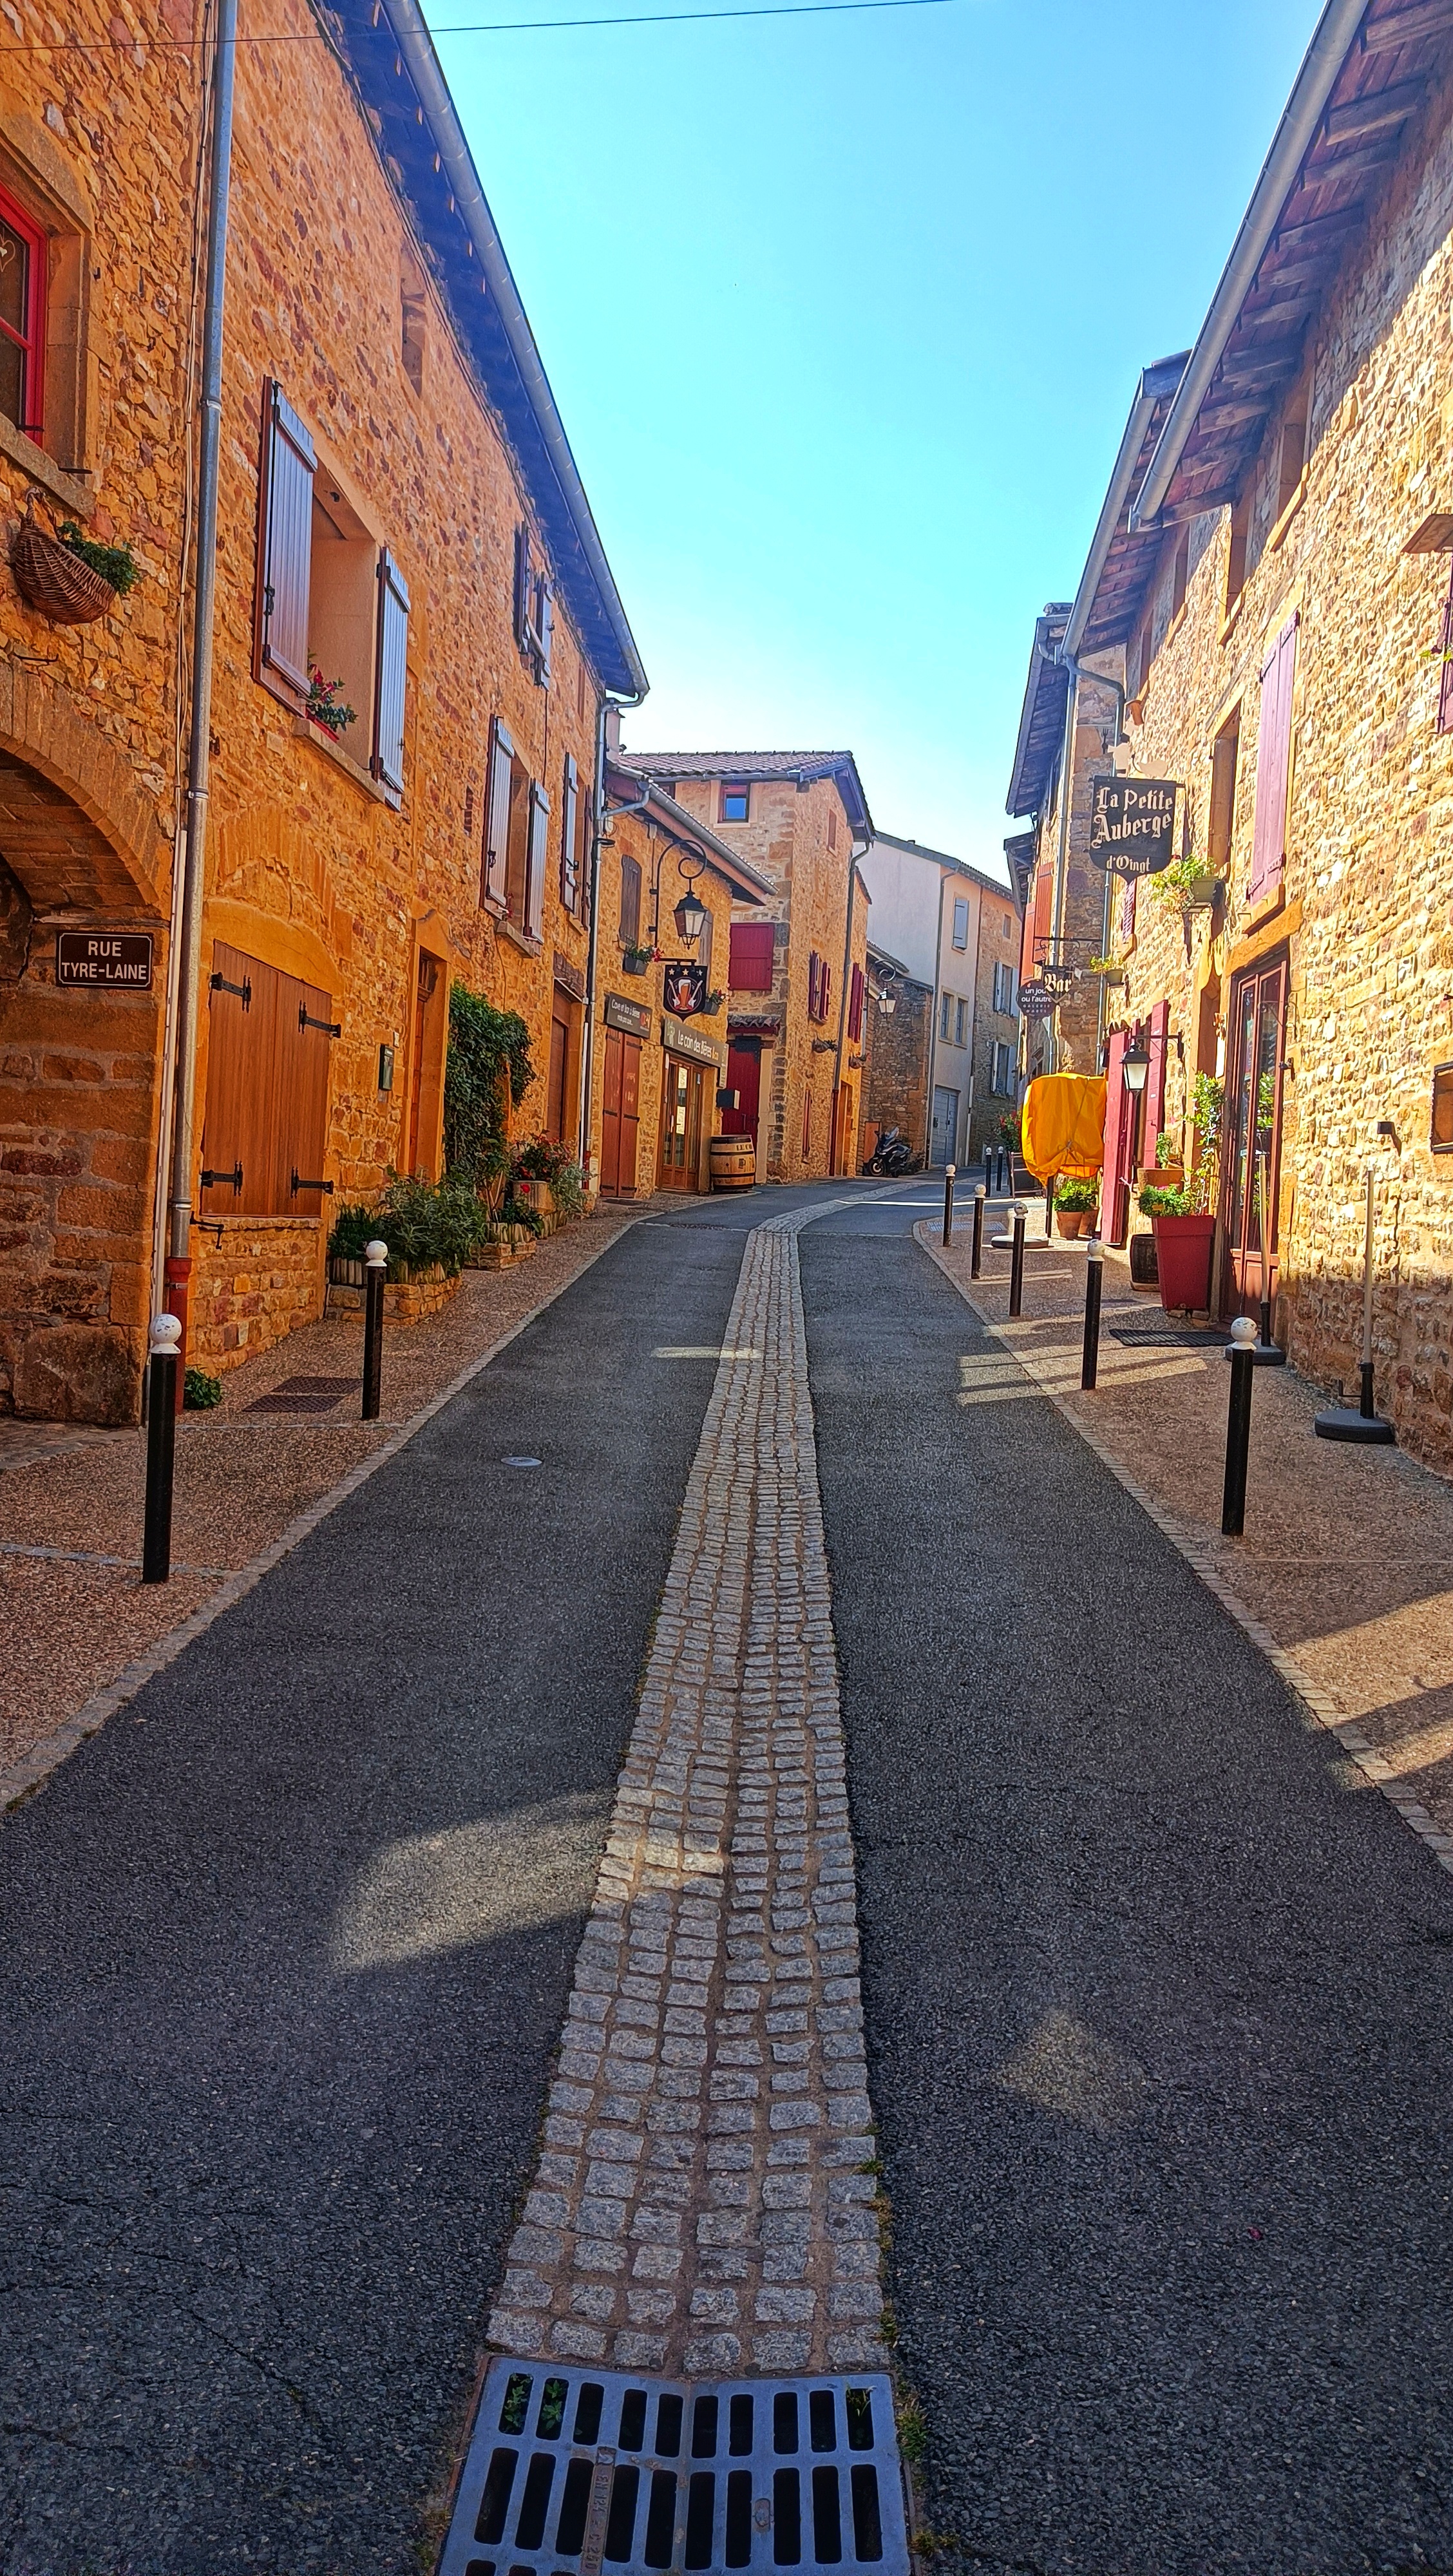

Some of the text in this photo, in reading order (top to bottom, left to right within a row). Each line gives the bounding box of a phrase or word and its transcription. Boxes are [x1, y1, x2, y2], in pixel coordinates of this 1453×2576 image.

[1096, 786, 1173, 813] La Petite
[1091, 813, 1172, 849] Auberge
[1106, 855, 1151, 873] d'Oingt
[88, 940, 122, 957] RUE
[61, 961, 147, 980] TYRE-LAINE
[1044, 973, 1072, 992] Bar
[678, 1030, 684, 1046] Le
[684, 1034, 694, 1050] coin
